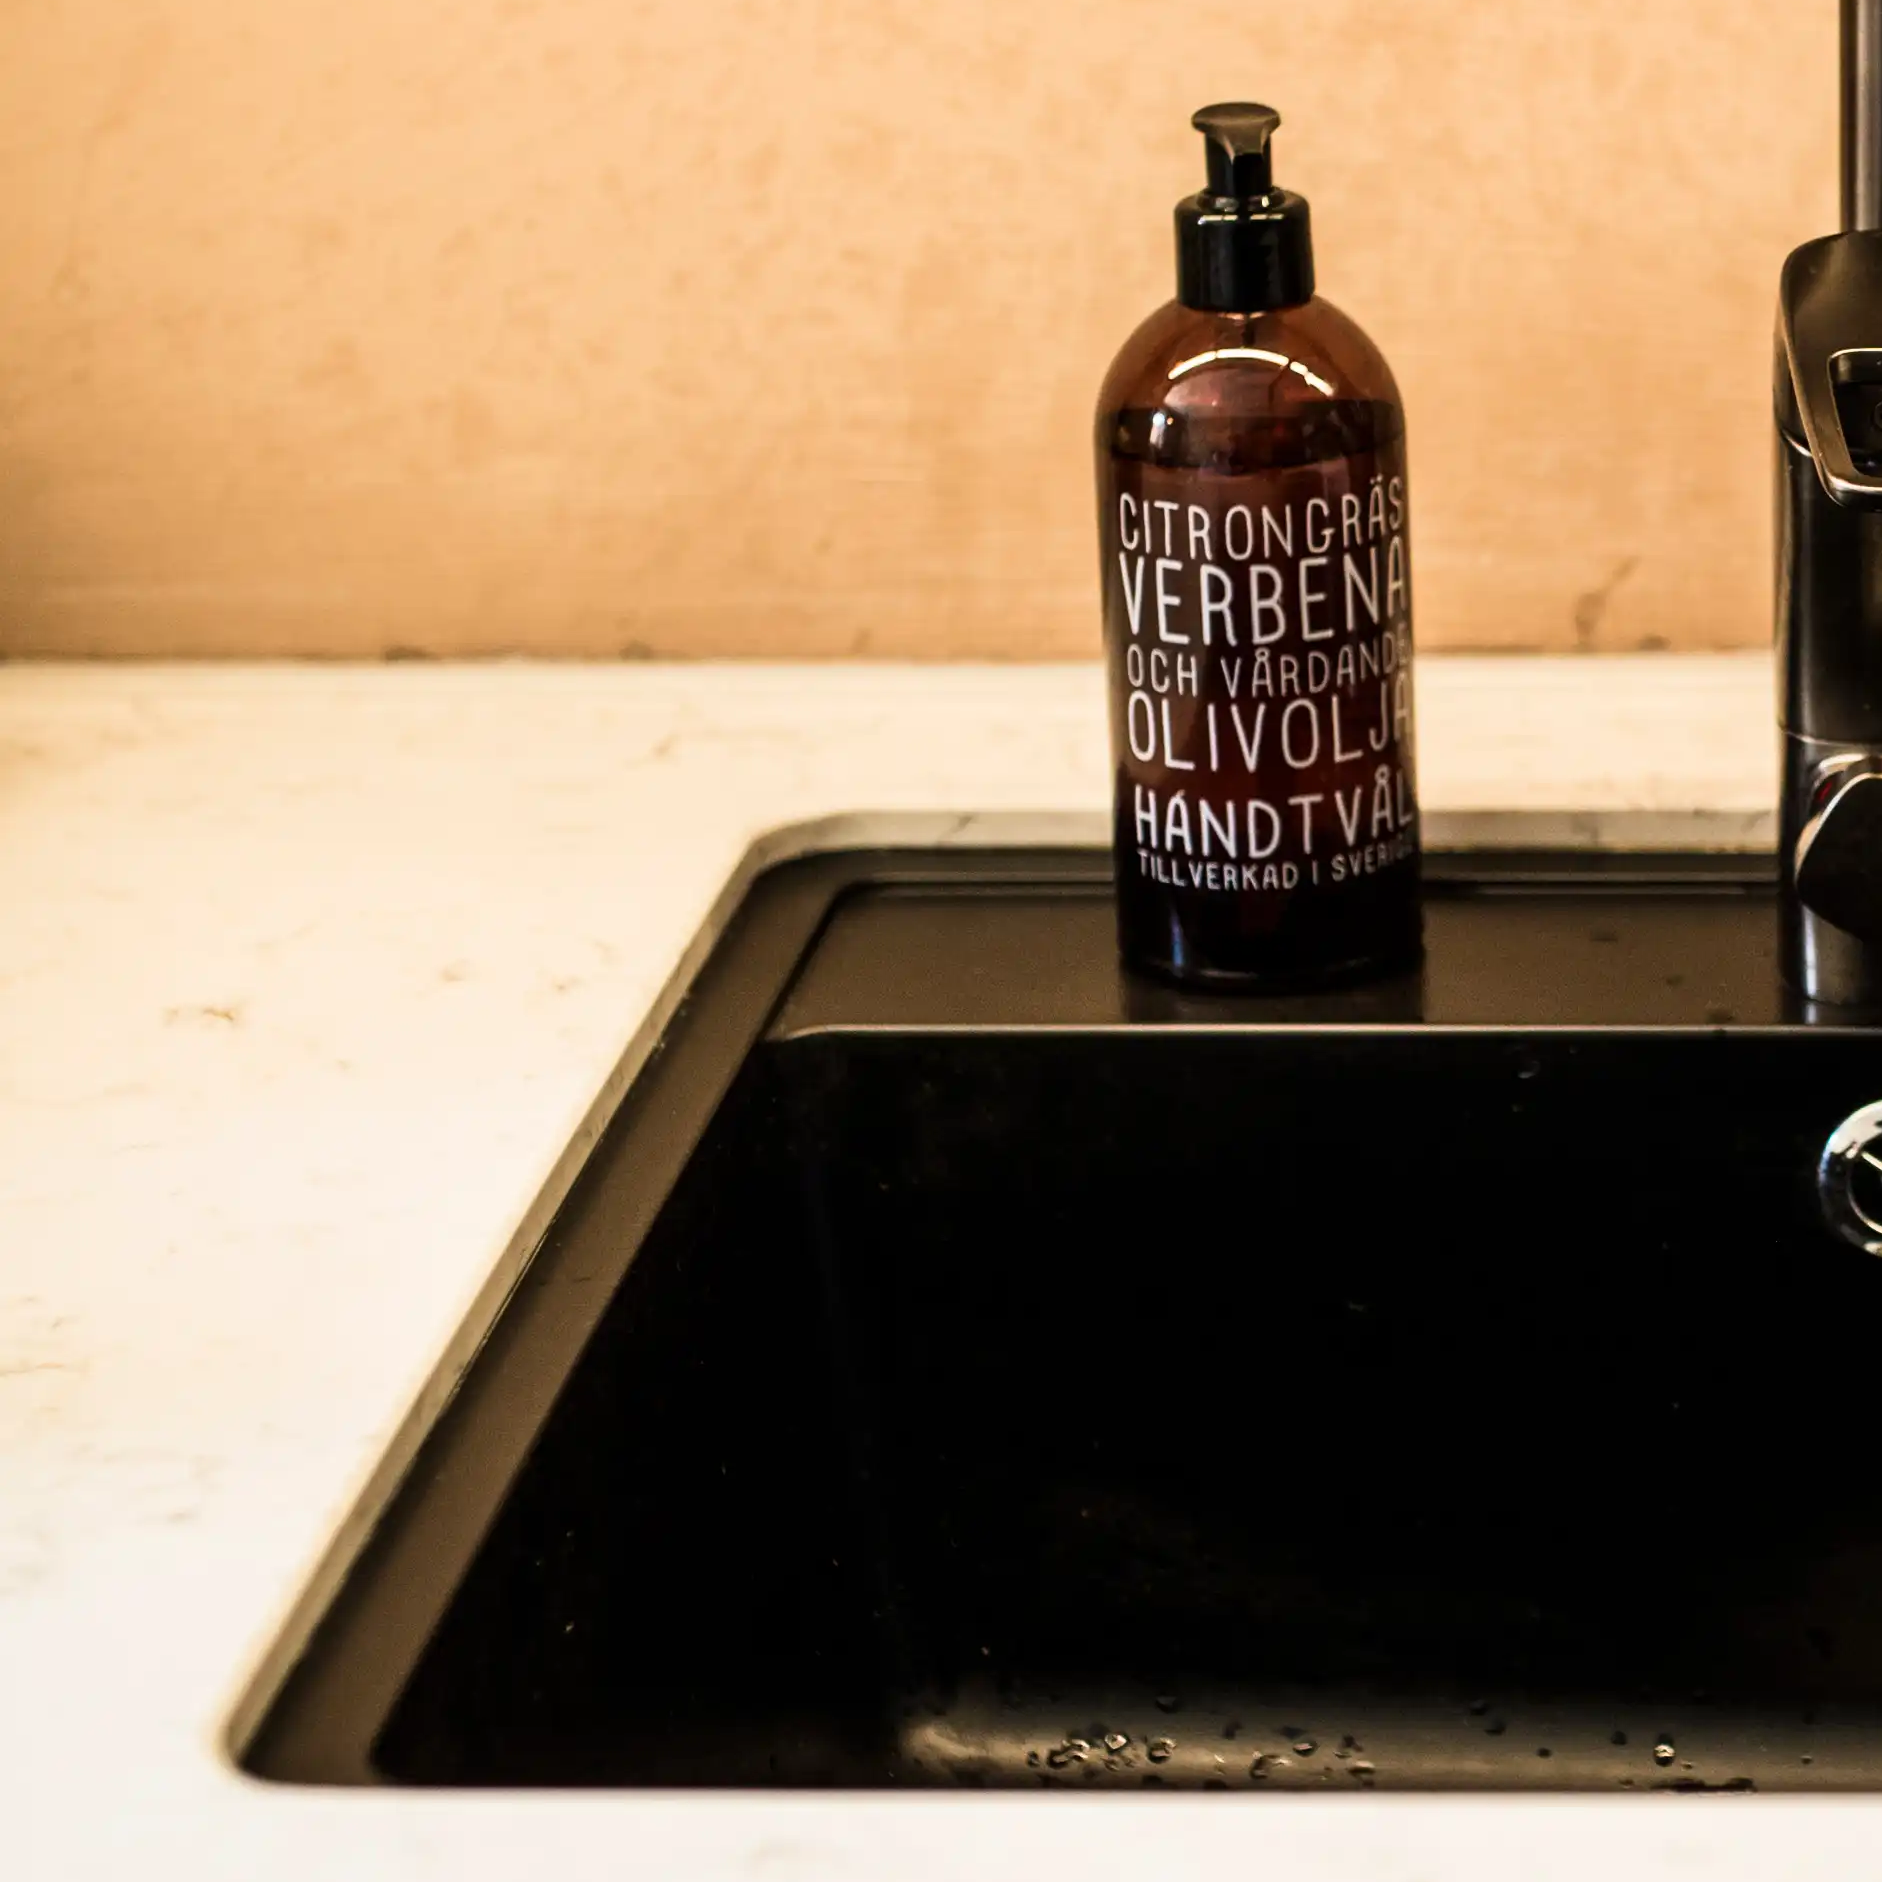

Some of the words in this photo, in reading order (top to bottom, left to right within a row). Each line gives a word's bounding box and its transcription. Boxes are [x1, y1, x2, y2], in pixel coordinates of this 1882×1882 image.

[1119, 473, 1404, 562] CITRONGRÄS
[1119, 535, 1407, 646] VERBENA
[1127, 644, 1198, 697] OCH
[1128, 670, 1412, 773] OLIVOLJA
[1137, 848, 1298, 891] TILLVERKAD
[1311, 859, 1320, 886] I
